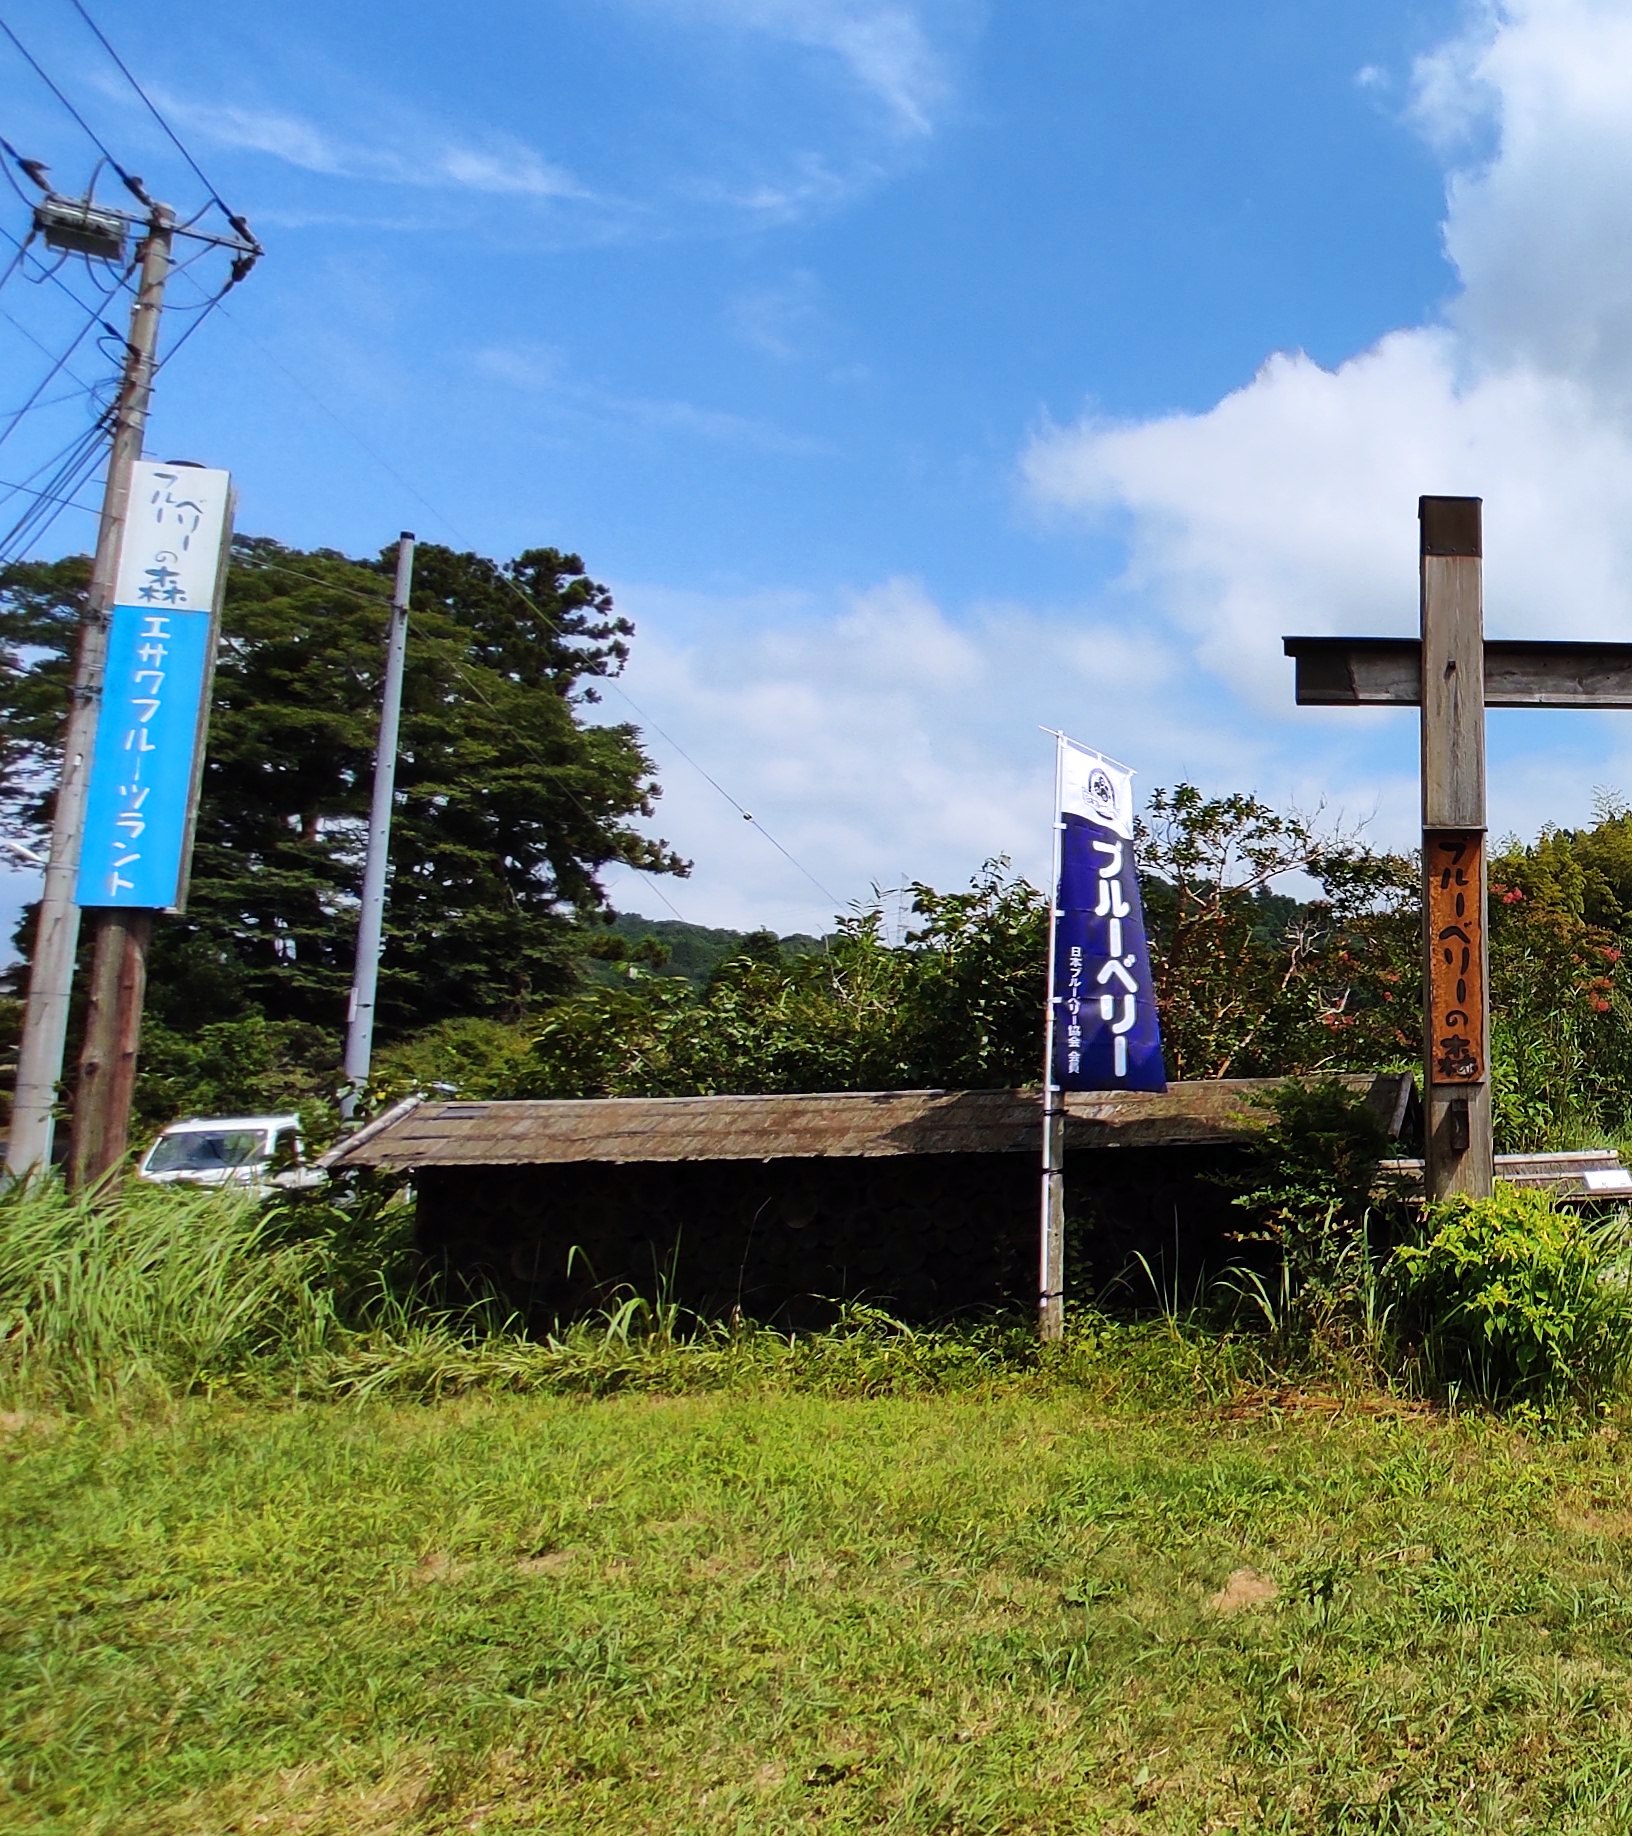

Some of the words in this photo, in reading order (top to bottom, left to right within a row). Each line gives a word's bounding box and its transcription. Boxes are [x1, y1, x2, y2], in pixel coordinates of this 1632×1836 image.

[1068, 946, 1083, 1047] 日本ブルーベリー協会
[1093, 840, 1139, 1078] ブルーベリー
[1438, 836, 1479, 1077] ブルーベリーの森
